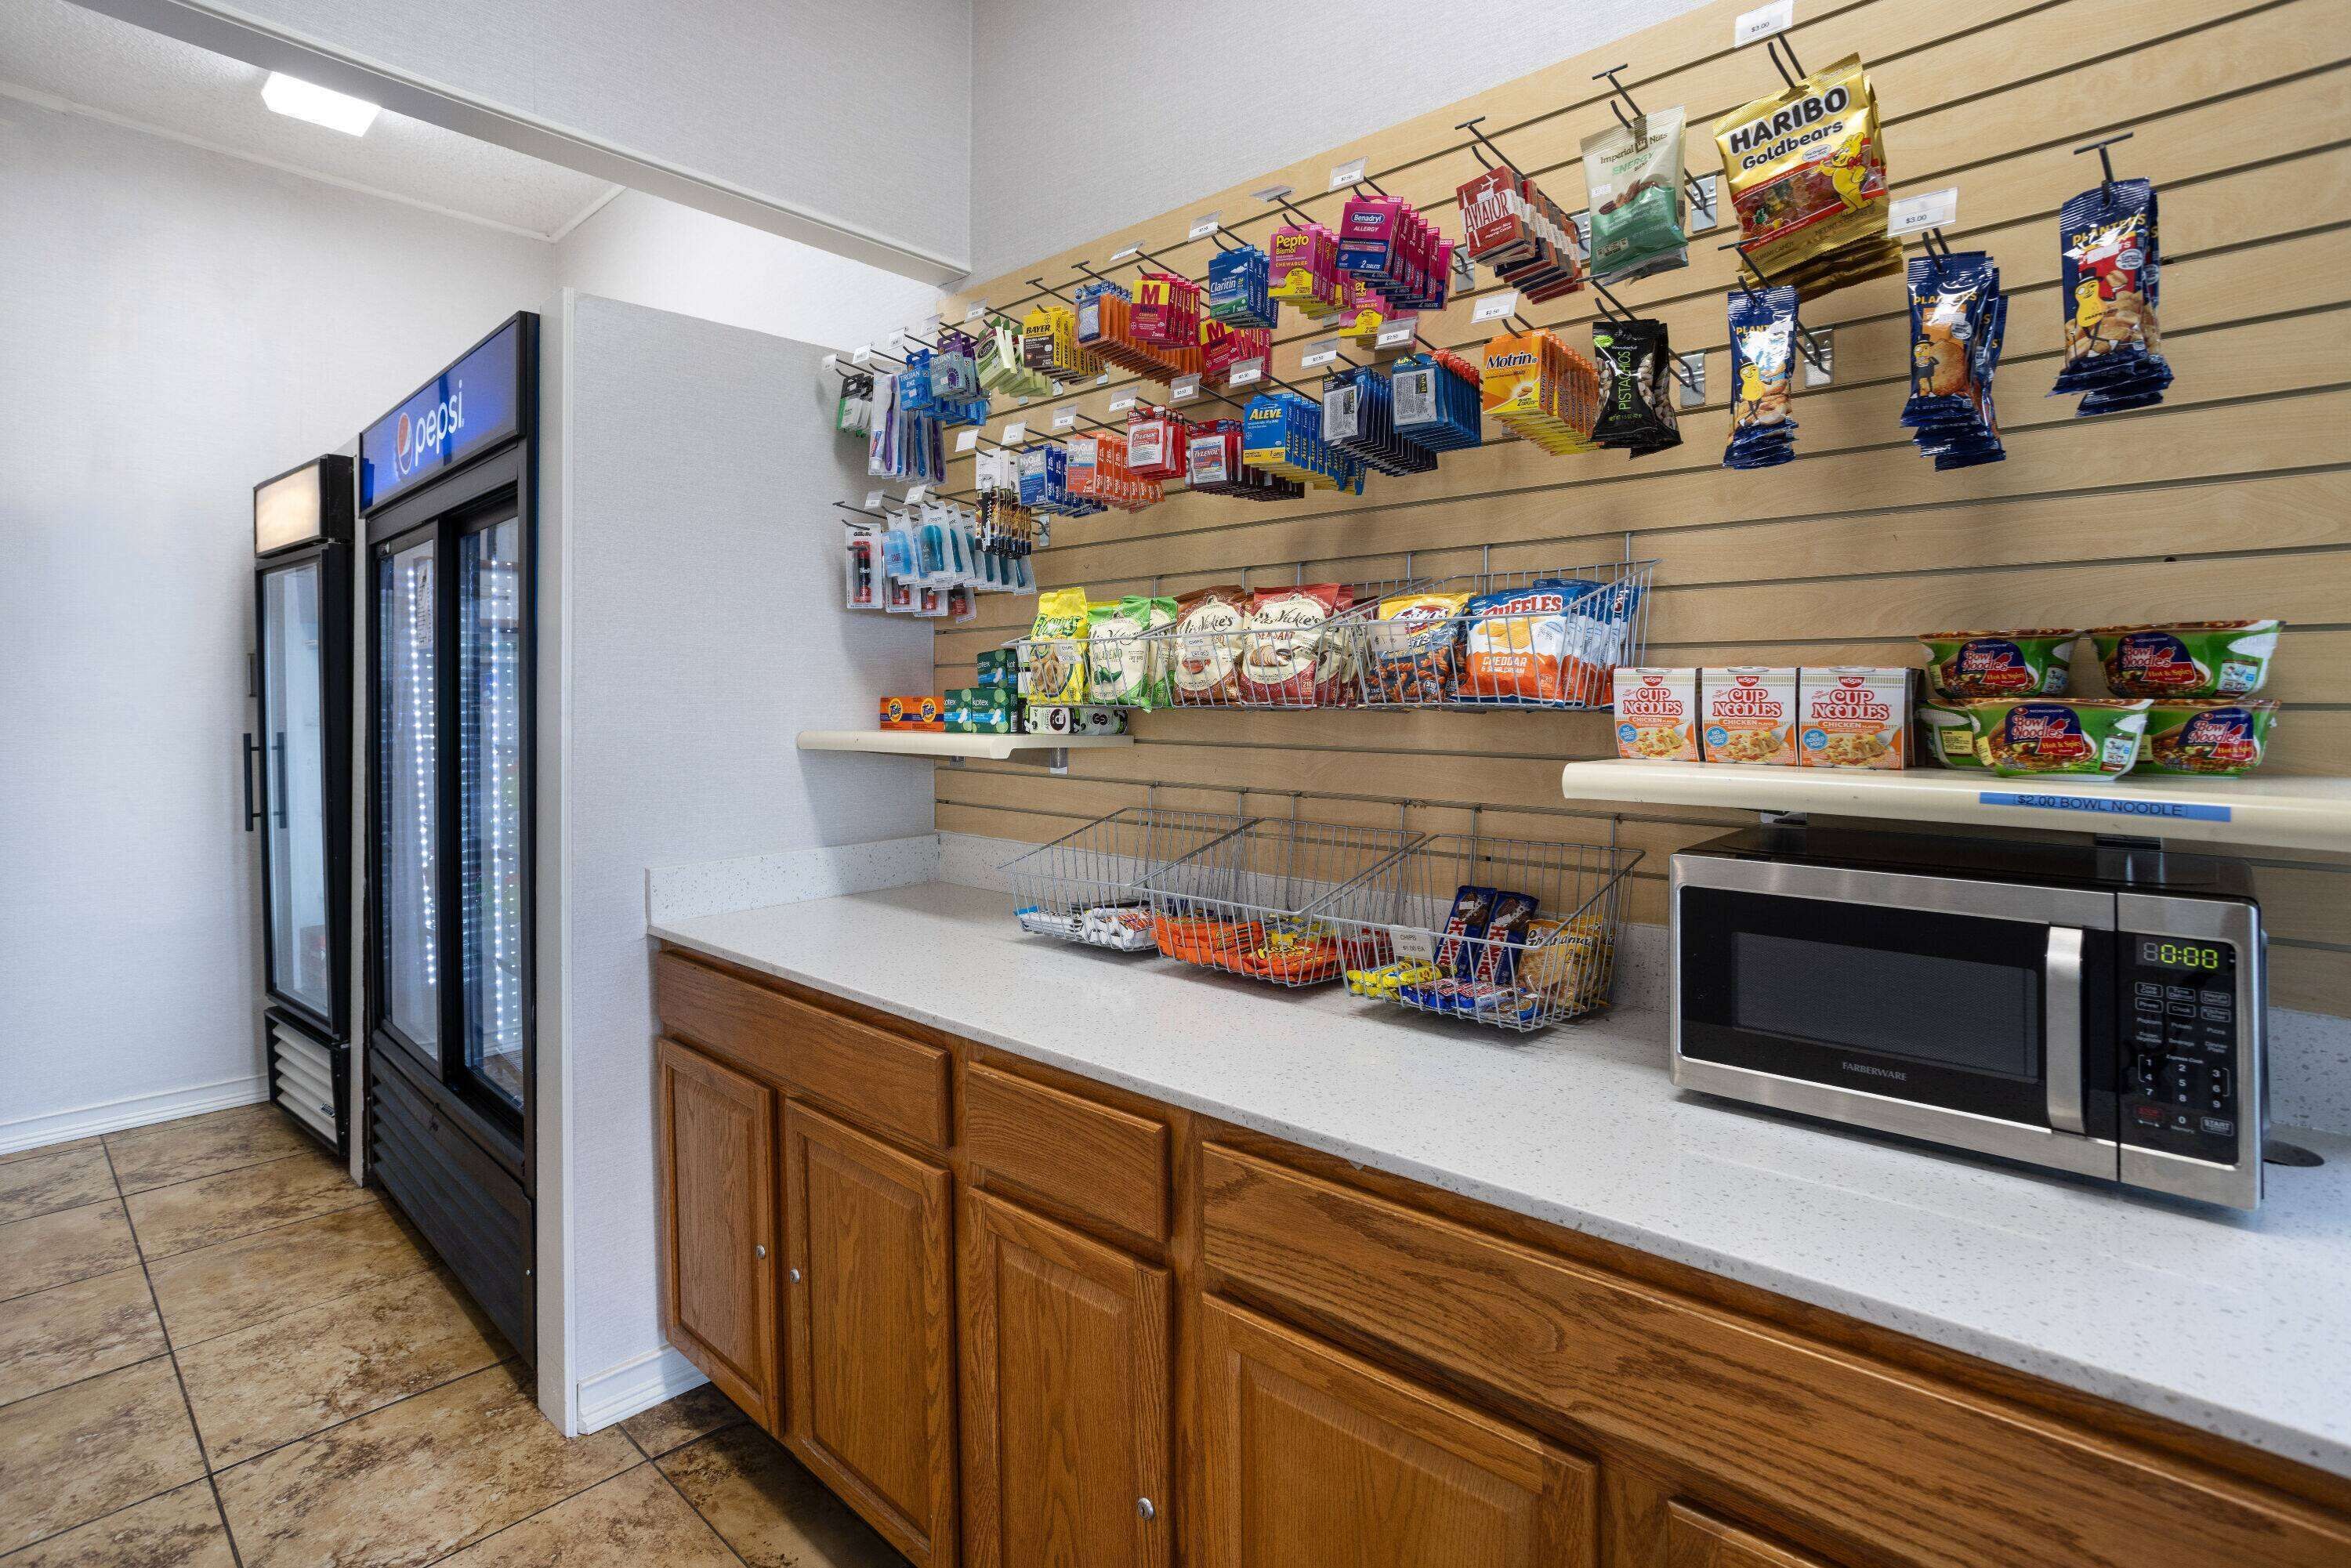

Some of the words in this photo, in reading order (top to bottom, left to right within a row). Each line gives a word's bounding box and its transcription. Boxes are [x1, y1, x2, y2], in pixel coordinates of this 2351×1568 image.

[1751, 21, 1770, 33] $3.00
[1730, 86, 1848, 154] HARIBO
[1599, 144, 1635, 164] Imperial
[1649, 132, 1668, 145] Nuts
[1742, 121, 1843, 170] Goldbears
[1354, 214, 1382, 223] Benadryl
[1463, 190, 1510, 249] AVIATOR
[1906, 214, 1927, 224] $3.00
[1276, 234, 1310, 248] Pepto
[1210, 280, 1237, 293] Claritin
[1140, 284, 1161, 305] M
[1139, 305, 1158, 313] Midol
[1026, 324, 1052, 335] BAYER
[1486, 351, 1534, 369] Motrin
[900, 370, 920, 382] TROJAN
[1249, 408, 1283, 421] ALEVE
[415, 379, 463, 467] pepsi
[1068, 443, 1094, 455] DayQuil
[1194, 447, 1220, 458] TYLENOL
[1020, 455, 1041, 466] NyQuil
[1483, 596, 1563, 617] RUFFLES
[1965, 650, 1994, 661] Bowl
[2123, 646, 2154, 657] Bowl
[1482, 656, 1527, 667] CHEDDAR
[1962, 660, 2008, 672] Noodles
[2122, 656, 2171, 668] Noodles
[2148, 668, 2164, 677] Hot
[2172, 668, 2193, 678] Spicy
[1636, 688, 1671, 702] CUP
[1728, 688, 1768, 704] CUP
[1829, 689, 1875, 704] CUP
[972, 697, 989, 706] kotex
[1623, 700, 1683, 715] NOODLES
[1712, 701, 1782, 718] NOODLES
[1811, 702, 1889, 721] NOODLES
[2012, 715, 2049, 727] Bowl
[2194, 721, 2230, 732] Bowl
[2012, 726, 2063, 739] Noodles
[2188, 731, 2241, 743] Noodles
[2042, 741, 2056, 749] Hot
[2017, 794, 2056, 808] $2.00
[2059, 796, 2106, 812] BOWL
[2110, 800, 2183, 817] NOODLE
[2161, 943, 2219, 969] 0:00
[1842, 1062, 1907, 1081] FARBERWARE
[2212, 1070, 2220, 1078] 3
[2212, 1085, 2221, 1093] 6
[2179, 1094, 2187, 1103] 8
